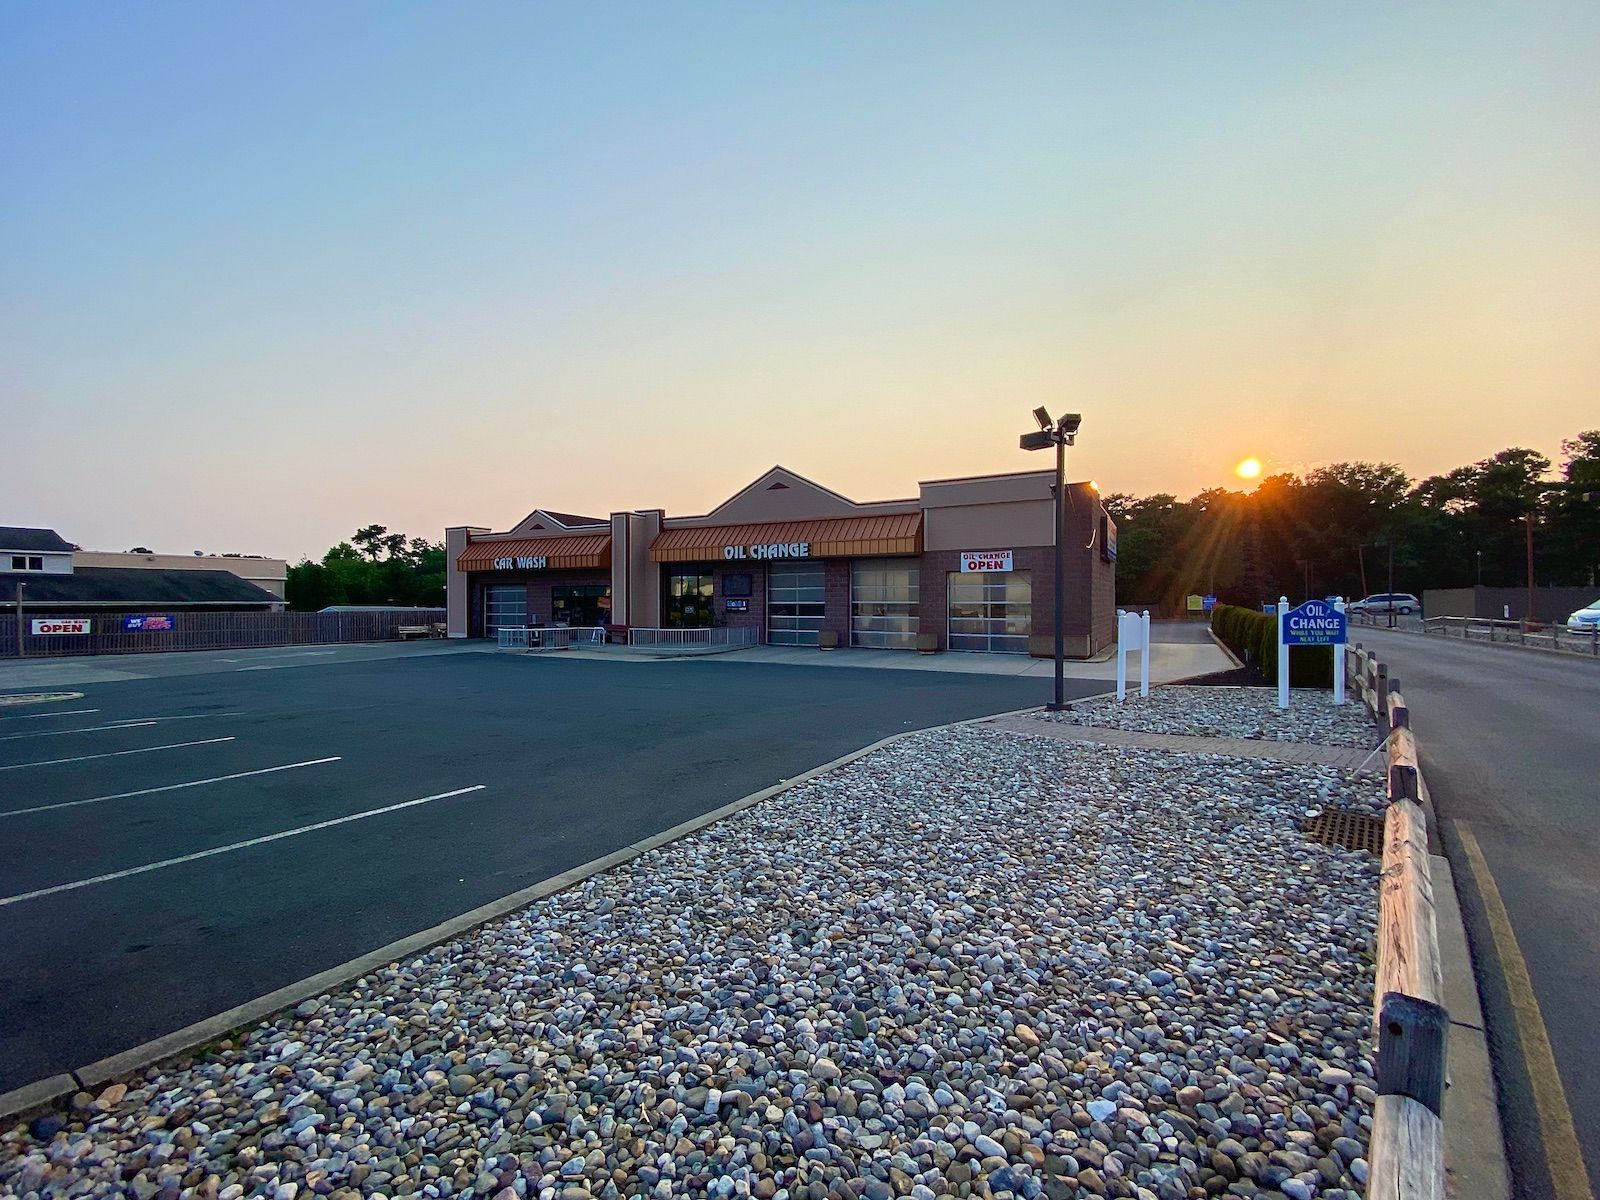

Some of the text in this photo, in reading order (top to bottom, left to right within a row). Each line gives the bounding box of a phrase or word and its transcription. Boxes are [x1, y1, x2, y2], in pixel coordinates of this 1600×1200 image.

[724, 542, 809, 560] OIL CHANGE
[978, 552, 1011, 560] CHANGE
[494, 555, 546, 570] CAR WASH
[968, 560, 1003, 570] OPEN
[1305, 604, 1325, 617] OIL
[40, 624, 83, 632] OPEN
[1290, 617, 1340, 629] CHANGE
